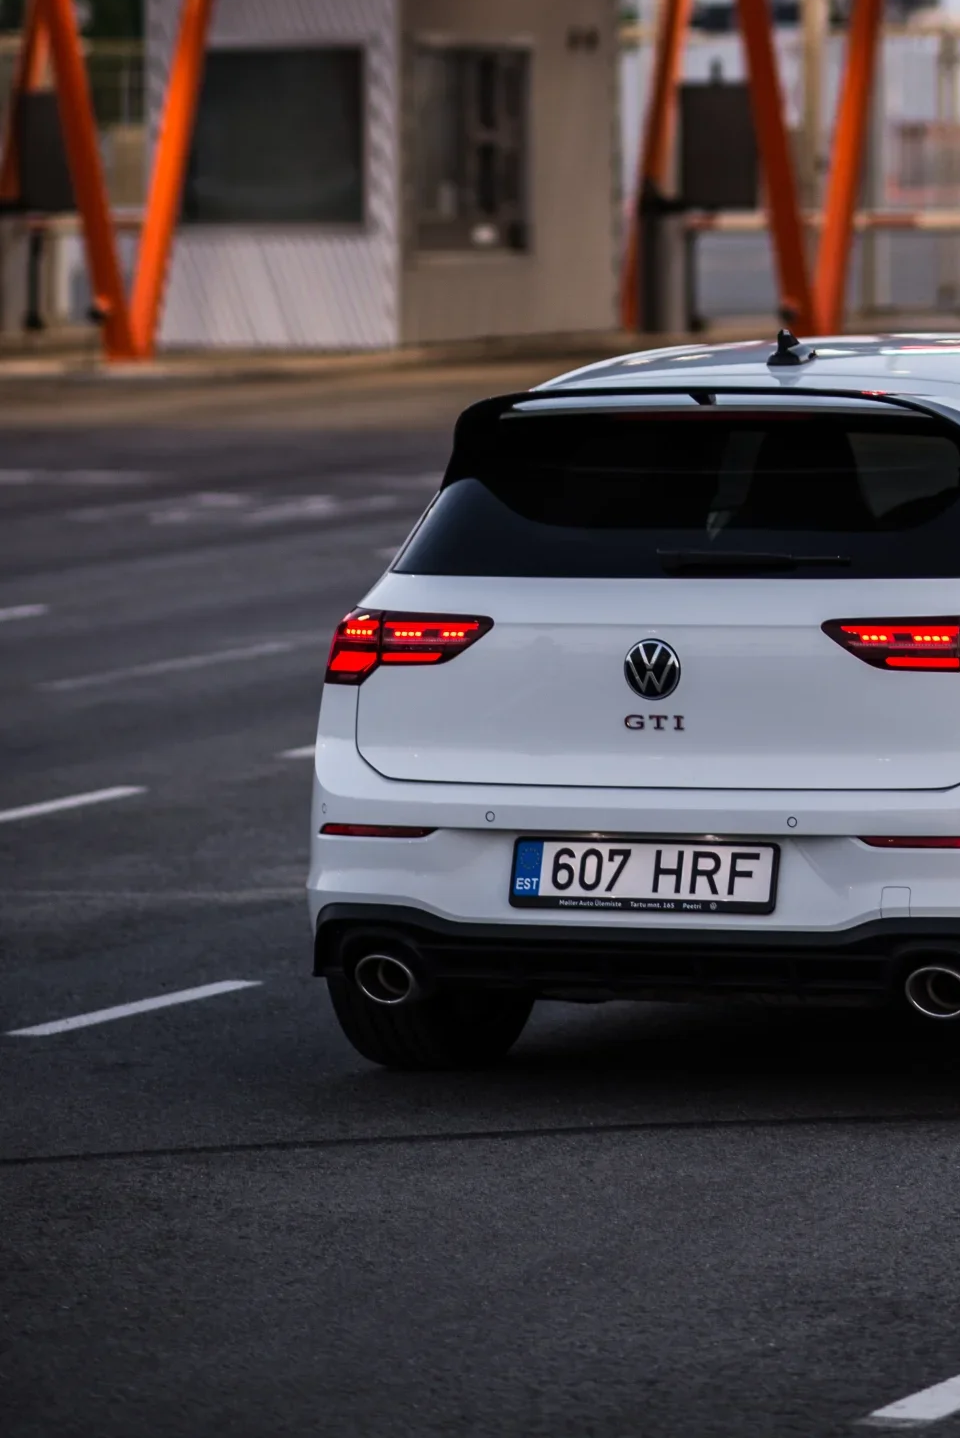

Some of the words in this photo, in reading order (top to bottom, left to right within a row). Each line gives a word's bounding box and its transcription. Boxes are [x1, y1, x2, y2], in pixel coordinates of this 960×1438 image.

[624, 714, 685, 731] GTI
[551, 847, 632, 892] 607
[651, 849, 761, 896] HRF
[515, 877, 539, 890] EST
